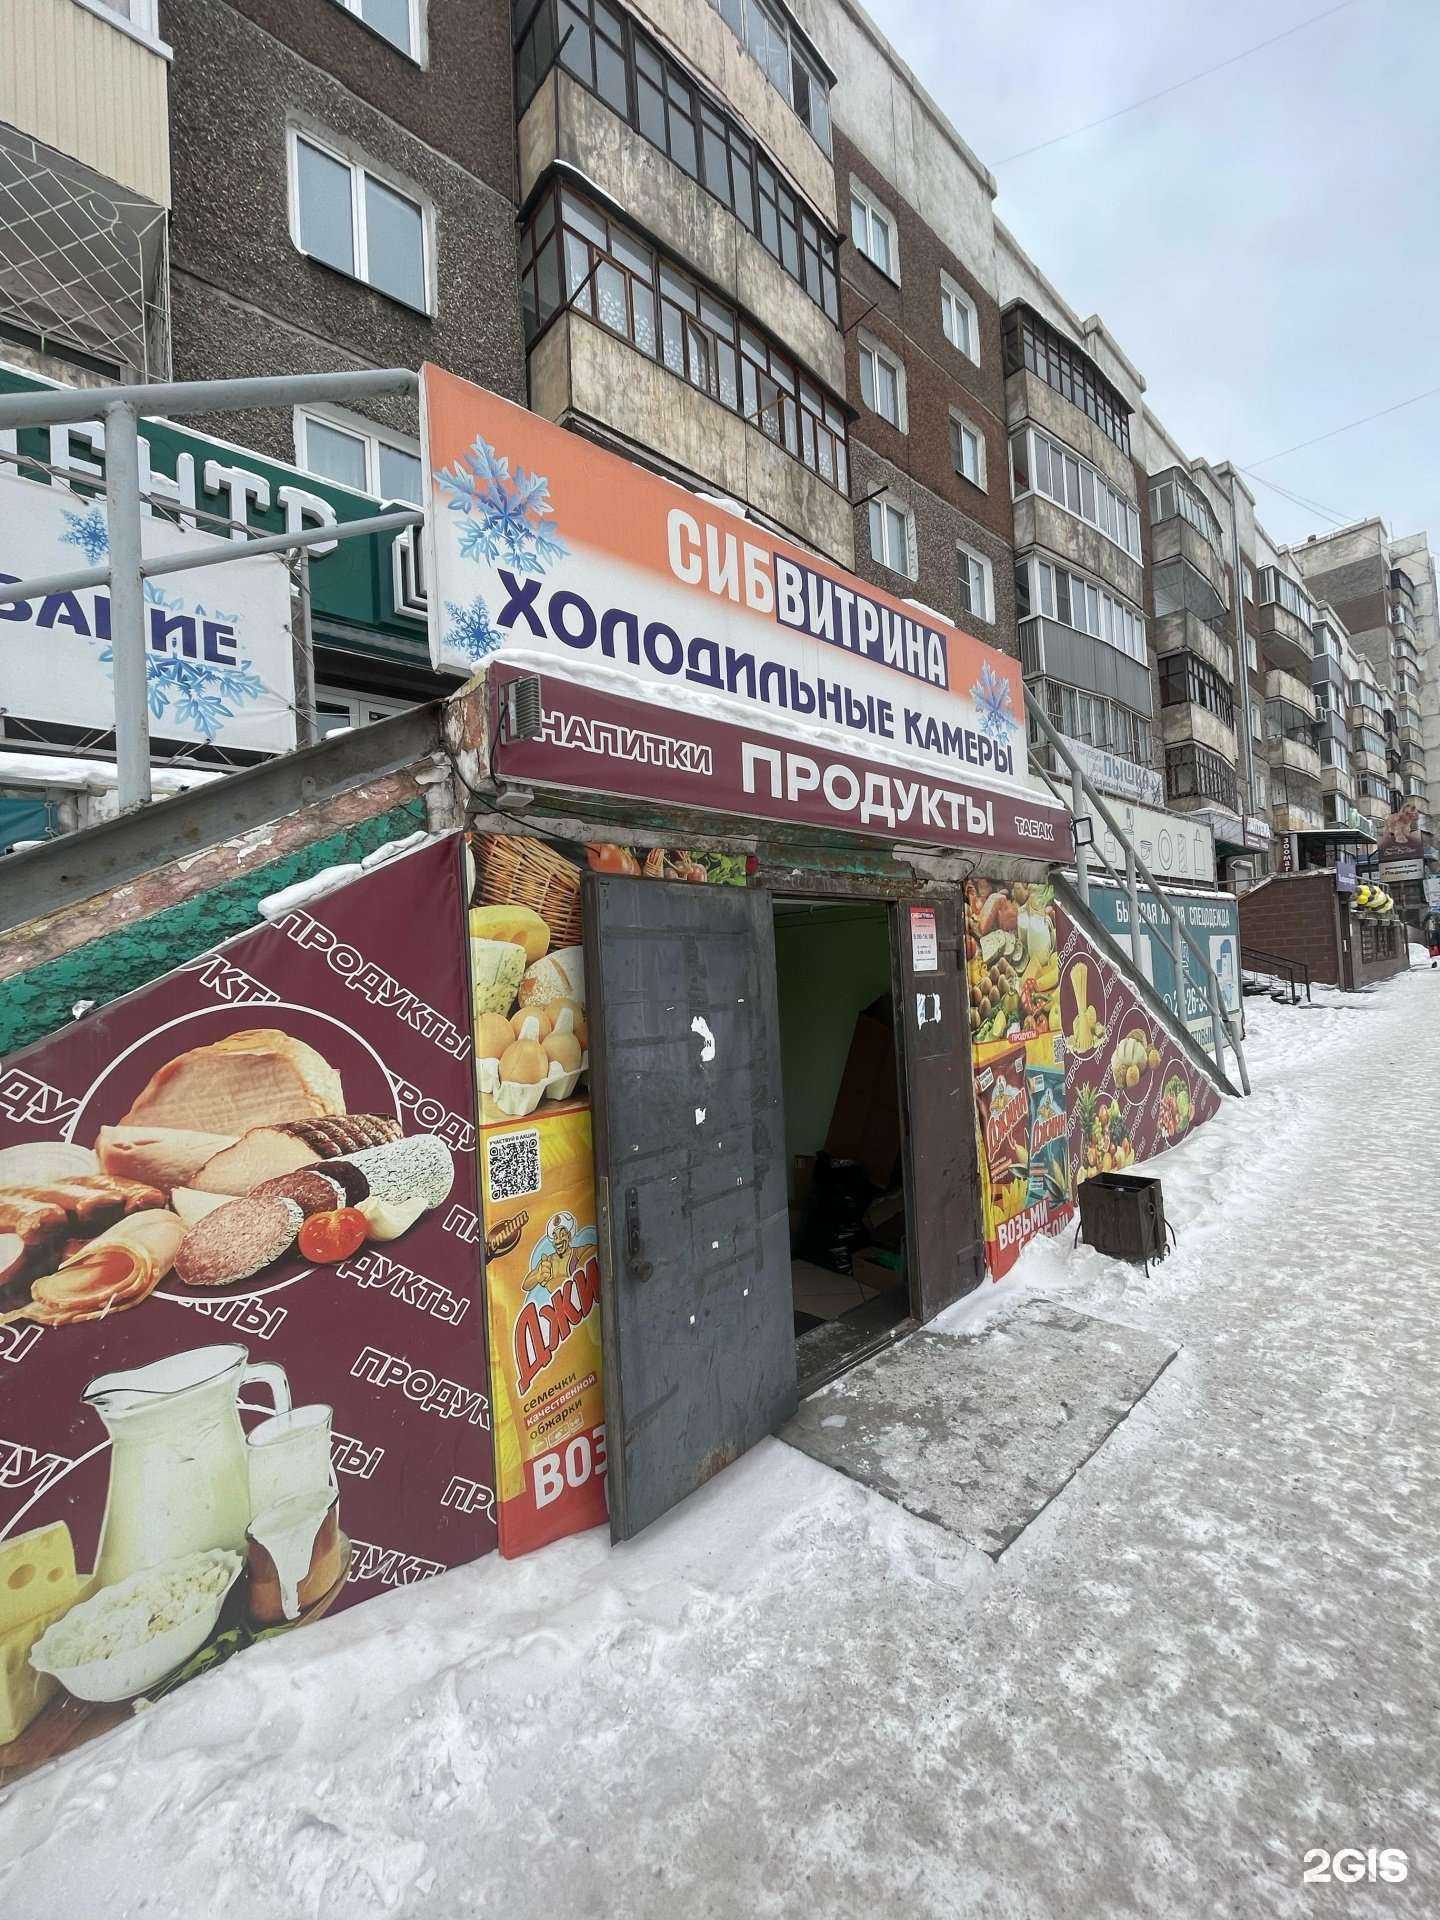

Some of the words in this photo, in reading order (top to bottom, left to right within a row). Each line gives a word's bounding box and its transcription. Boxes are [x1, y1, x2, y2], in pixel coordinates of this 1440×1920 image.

[497, 568, 894, 740] ХОЛОДИЛЬНЫЕ
[903, 708, 1014, 776] КАМЕРЫ
[532, 708, 713, 775] НАПИТКИ
[741, 742, 995, 837] ПРОДУКТЫ
[1014, 816, 1055, 841] ТАБАК
[1189, 907, 1231, 928] СПЕЦОДЕЖДА
[271, 909, 472, 1061] ПРОДУКТЫ
[998, 1199, 1049, 1250] ВОЗЬМИ
[523, 1372, 577, 1413] семечки
[526, 1373, 597, 1428] качественной
[529, 1399, 583, 1440] обжарки
